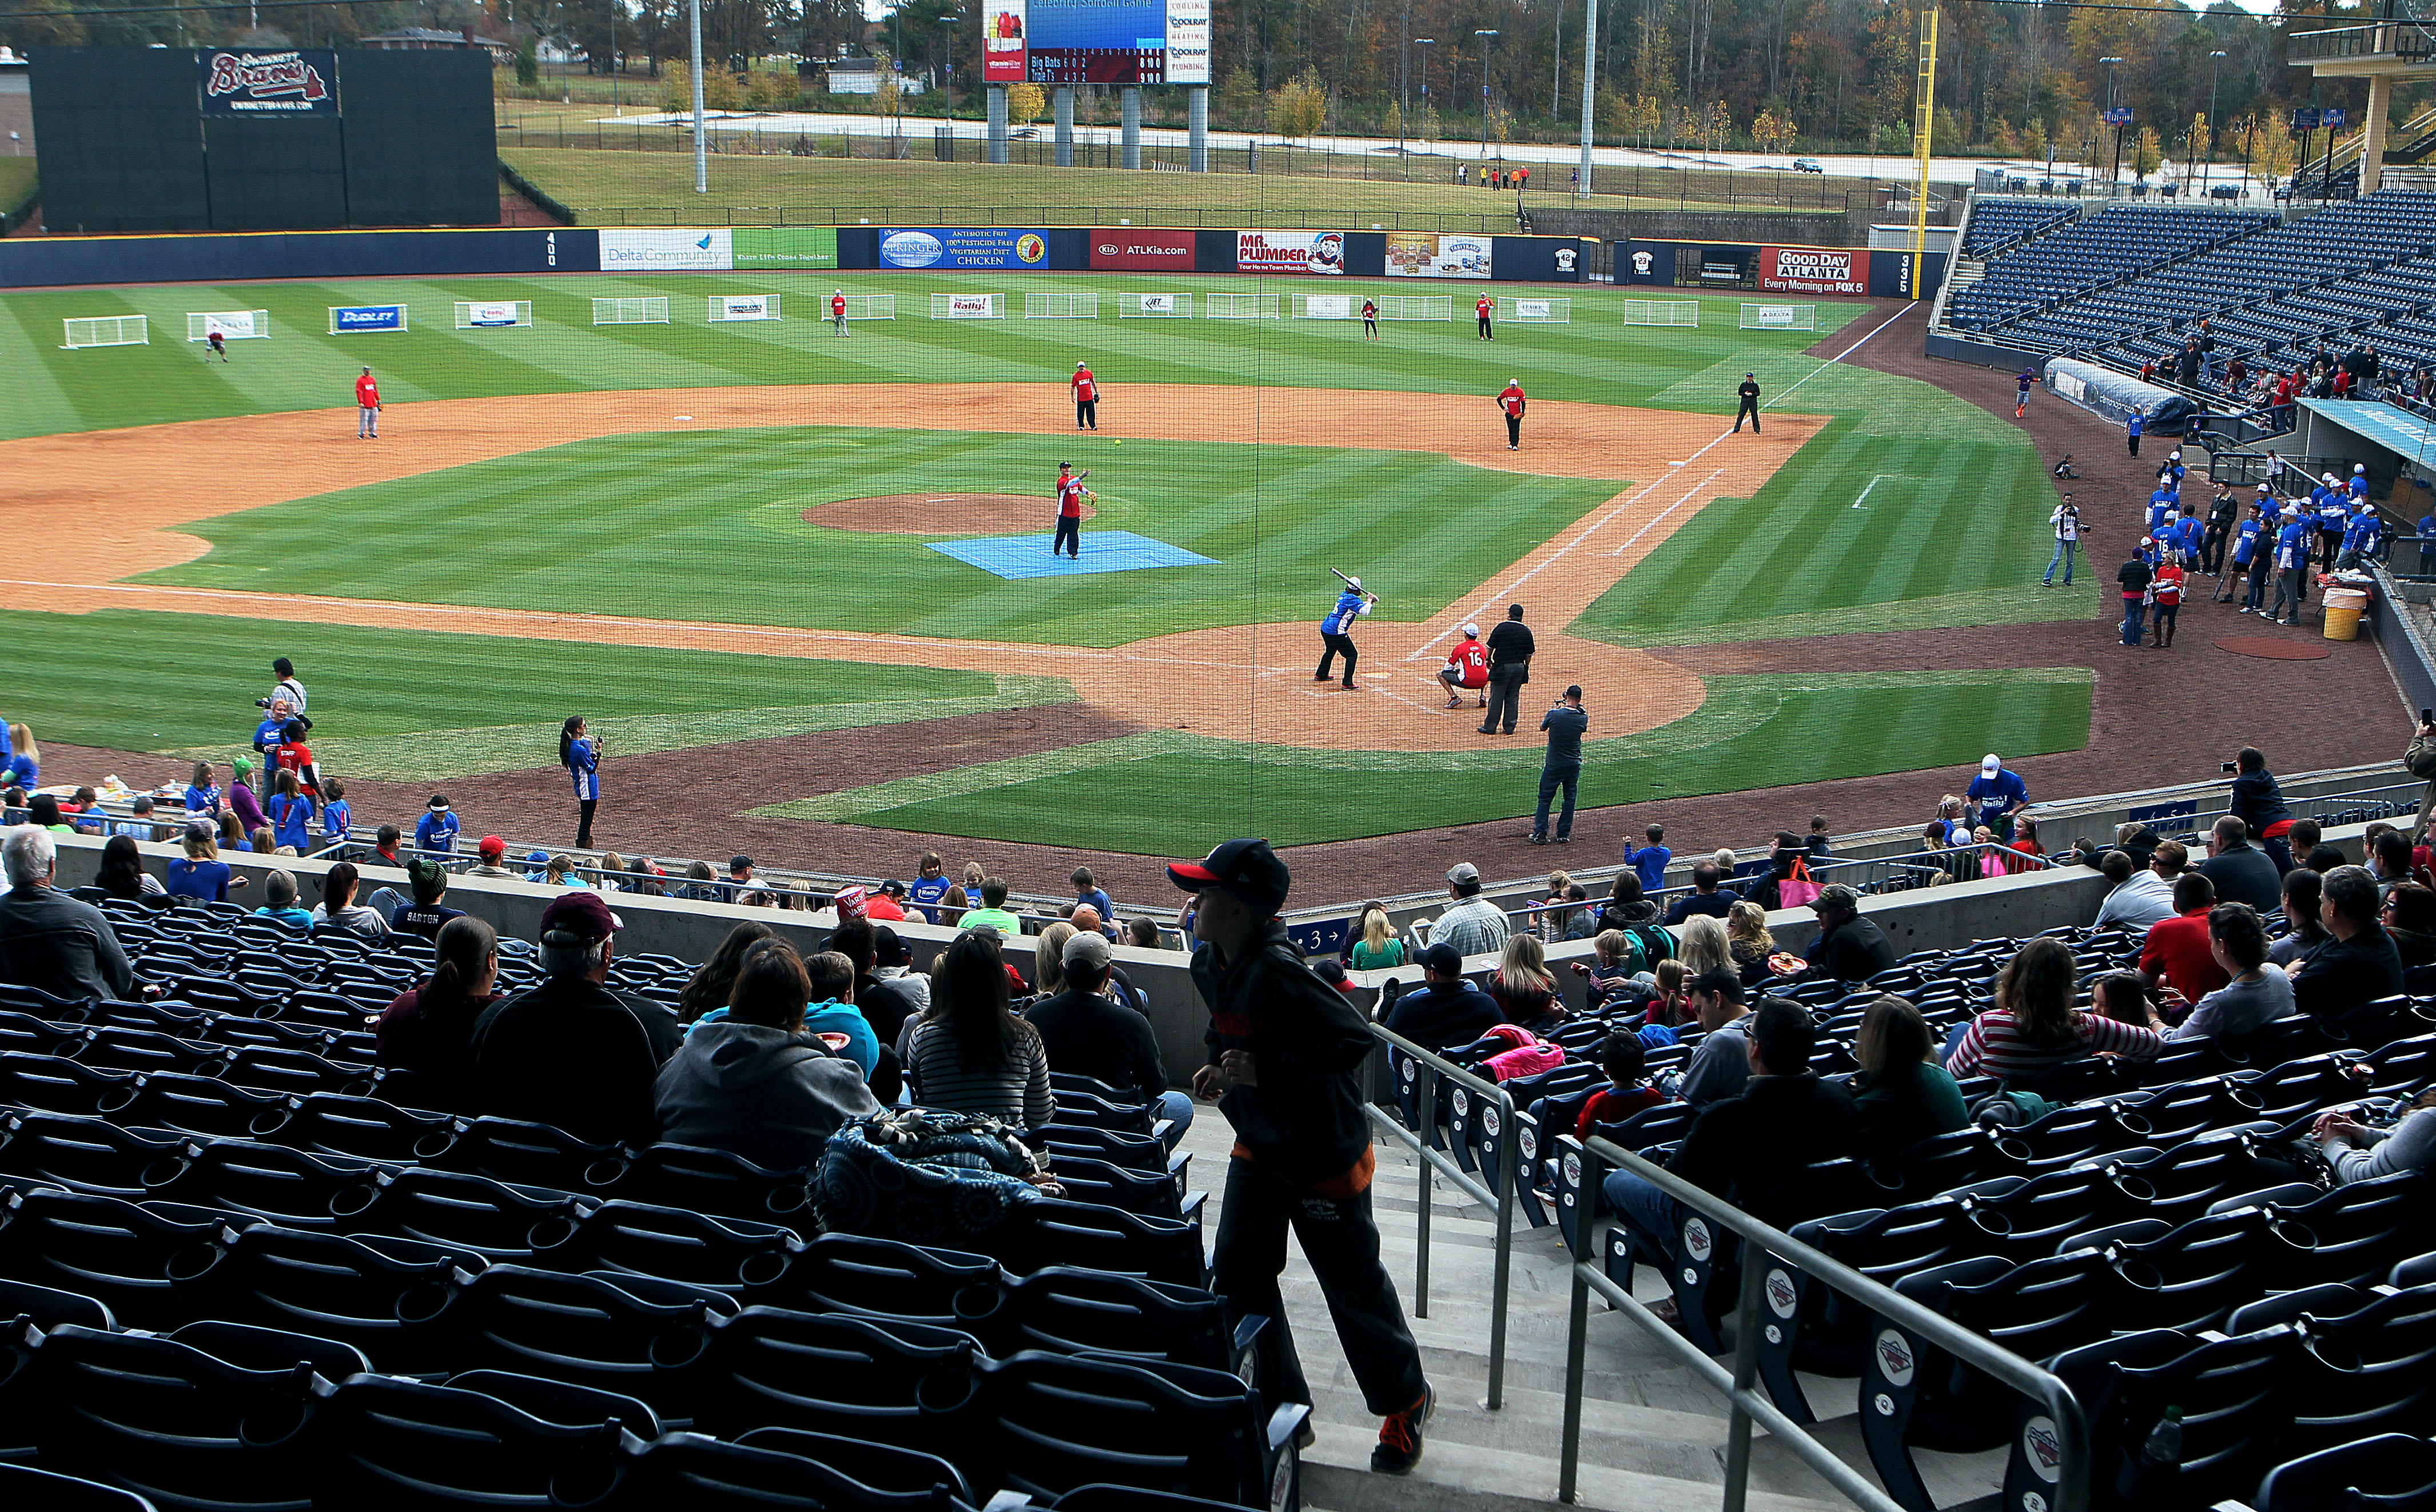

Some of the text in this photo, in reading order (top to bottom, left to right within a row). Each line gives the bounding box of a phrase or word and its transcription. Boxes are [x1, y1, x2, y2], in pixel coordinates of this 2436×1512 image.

[1171, 18, 1208, 27] COOLRAY
[1140, 48, 1145, 56] R
[1156, 48, 1160, 56] E
[1171, 48, 1208, 57] COOLRAY
[1031, 56, 1160, 70] Big Bats 6 0 2 8 10 0
[1172, 63, 1205, 71] PLUMBING
[207, 53, 305, 97] Braves
[1031, 69, 1046, 82] Triple
[1064, 72, 1069, 82] 4
[1072, 72, 1077, 82] 3
[1081, 72, 1086, 82] 2
[1140, 73, 1145, 83] 9
[1147, 73, 1154, 83] 10
[1156, 73, 1160, 83] 0
[881, 242, 940, 252] SPRINGER
[1240, 234, 1268, 248] MR.
[547, 232, 556, 266] 400
[949, 248, 991, 256] VEGETARIAN
[1127, 245, 1187, 255] ATLKia.com
[1240, 248, 1306, 261] PLUMBER
[609, 248, 719, 263] Delta Community
[957, 256, 1004, 265] CHICKEN
[1780, 252, 1848, 267] GOOD DAY
[1780, 266, 1846, 278] ATLANTA
[1900, 255, 1910, 293] 335
[1764, 278, 1864, 293] Every Morning on FOX 5
[954, 298, 986, 310] Rally!
[341, 312, 395, 323] DUDLEY
[2158, 540, 2169, 552] 16
[1468, 652, 1483, 666] 16
[1982, 795, 2008, 807] Rally!
[407, 912, 439, 924] BARTON
[1311, 930, 1321, 949] 3
